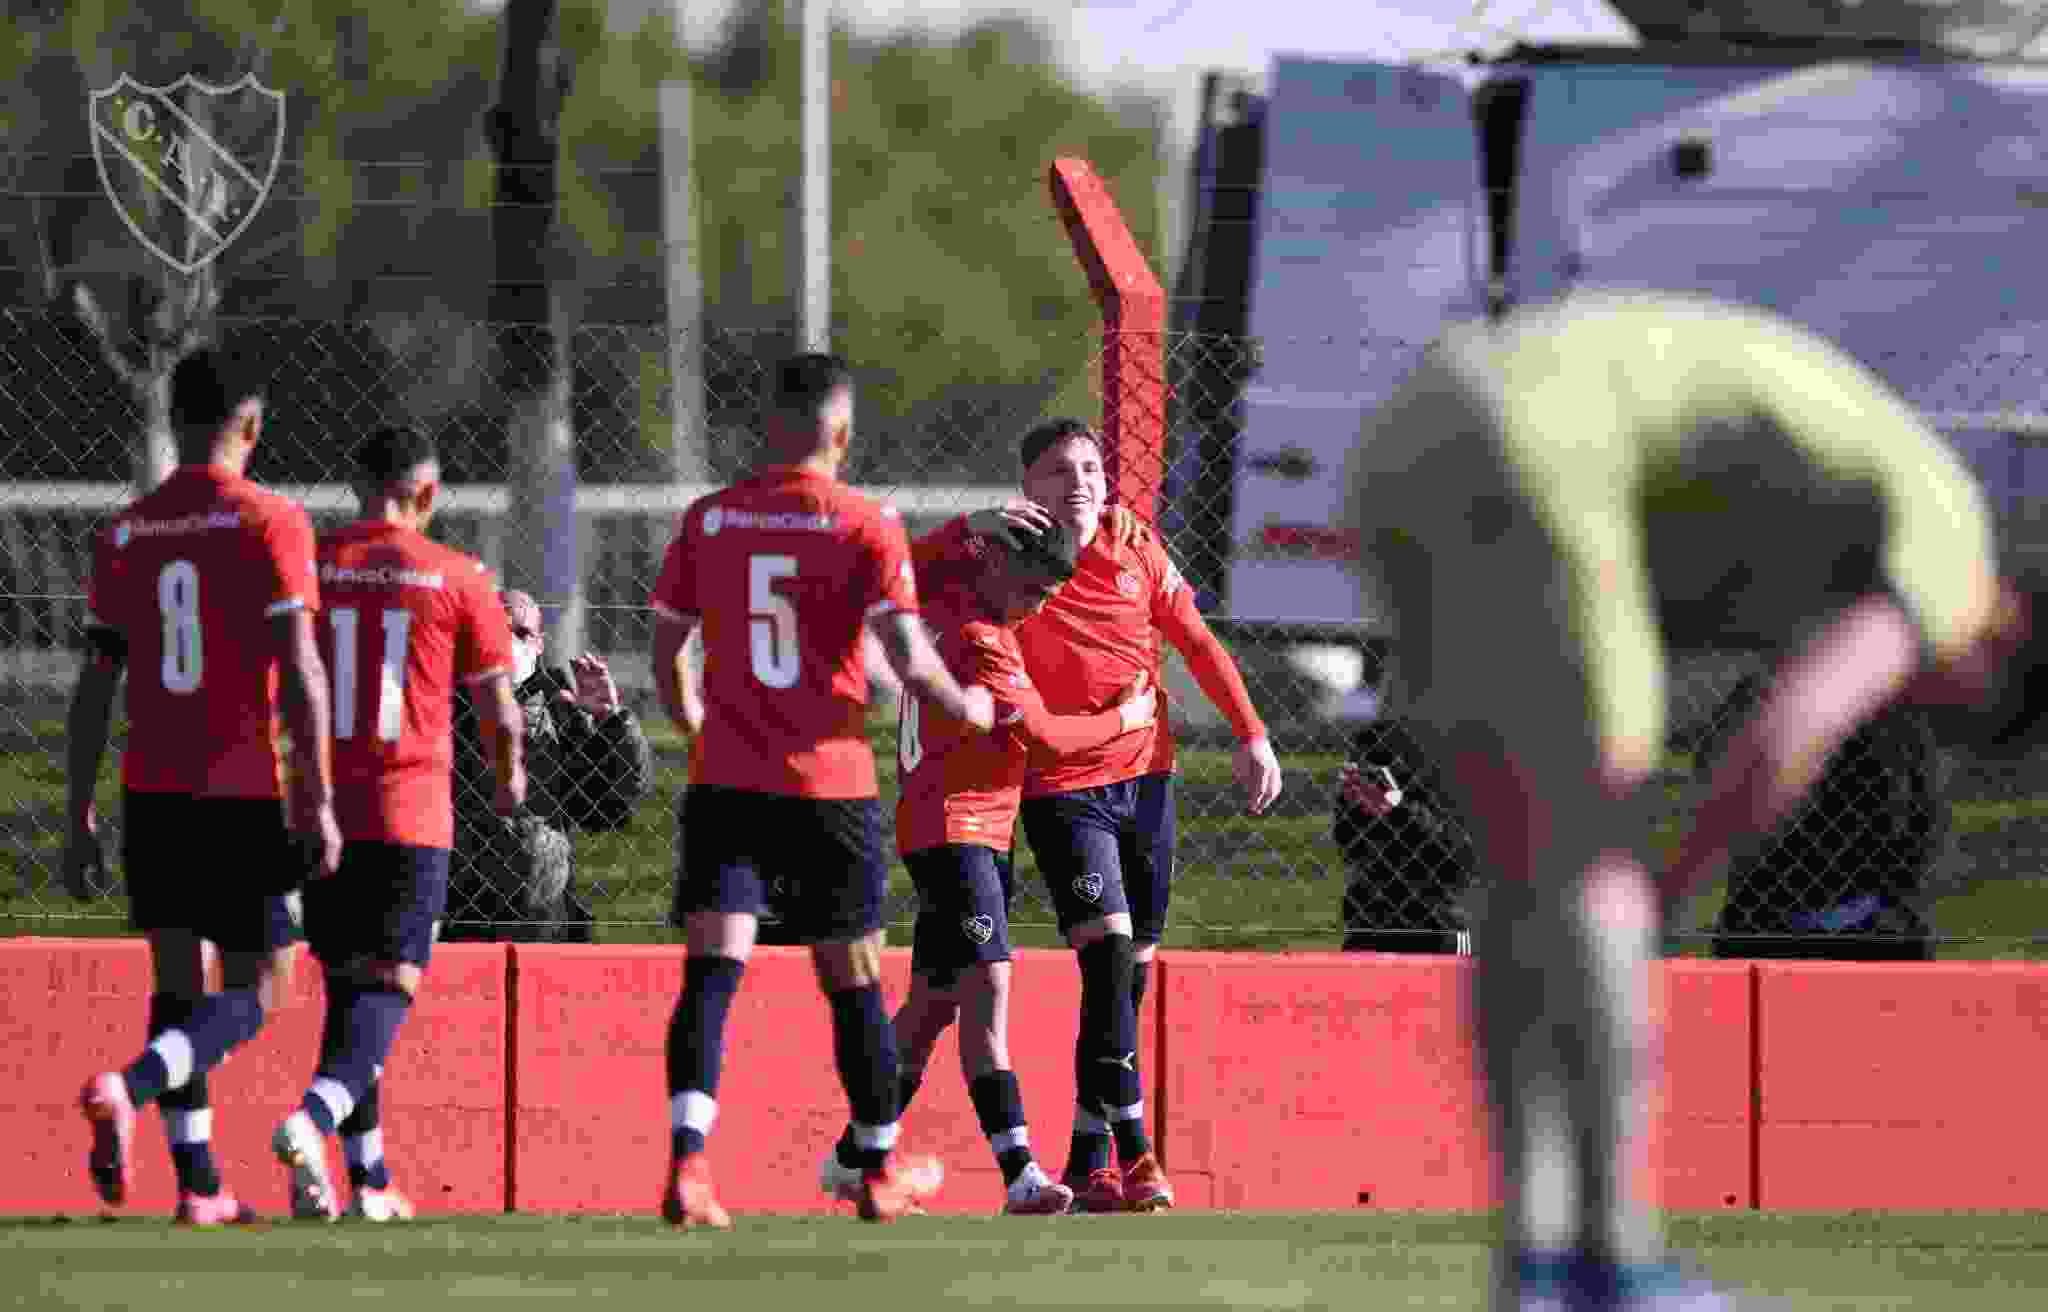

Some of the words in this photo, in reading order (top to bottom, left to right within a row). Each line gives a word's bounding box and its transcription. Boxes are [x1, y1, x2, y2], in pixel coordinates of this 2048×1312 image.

[158, 559, 203, 694] 8
[331, 607, 411, 741] 11
[749, 555, 799, 689] 5
